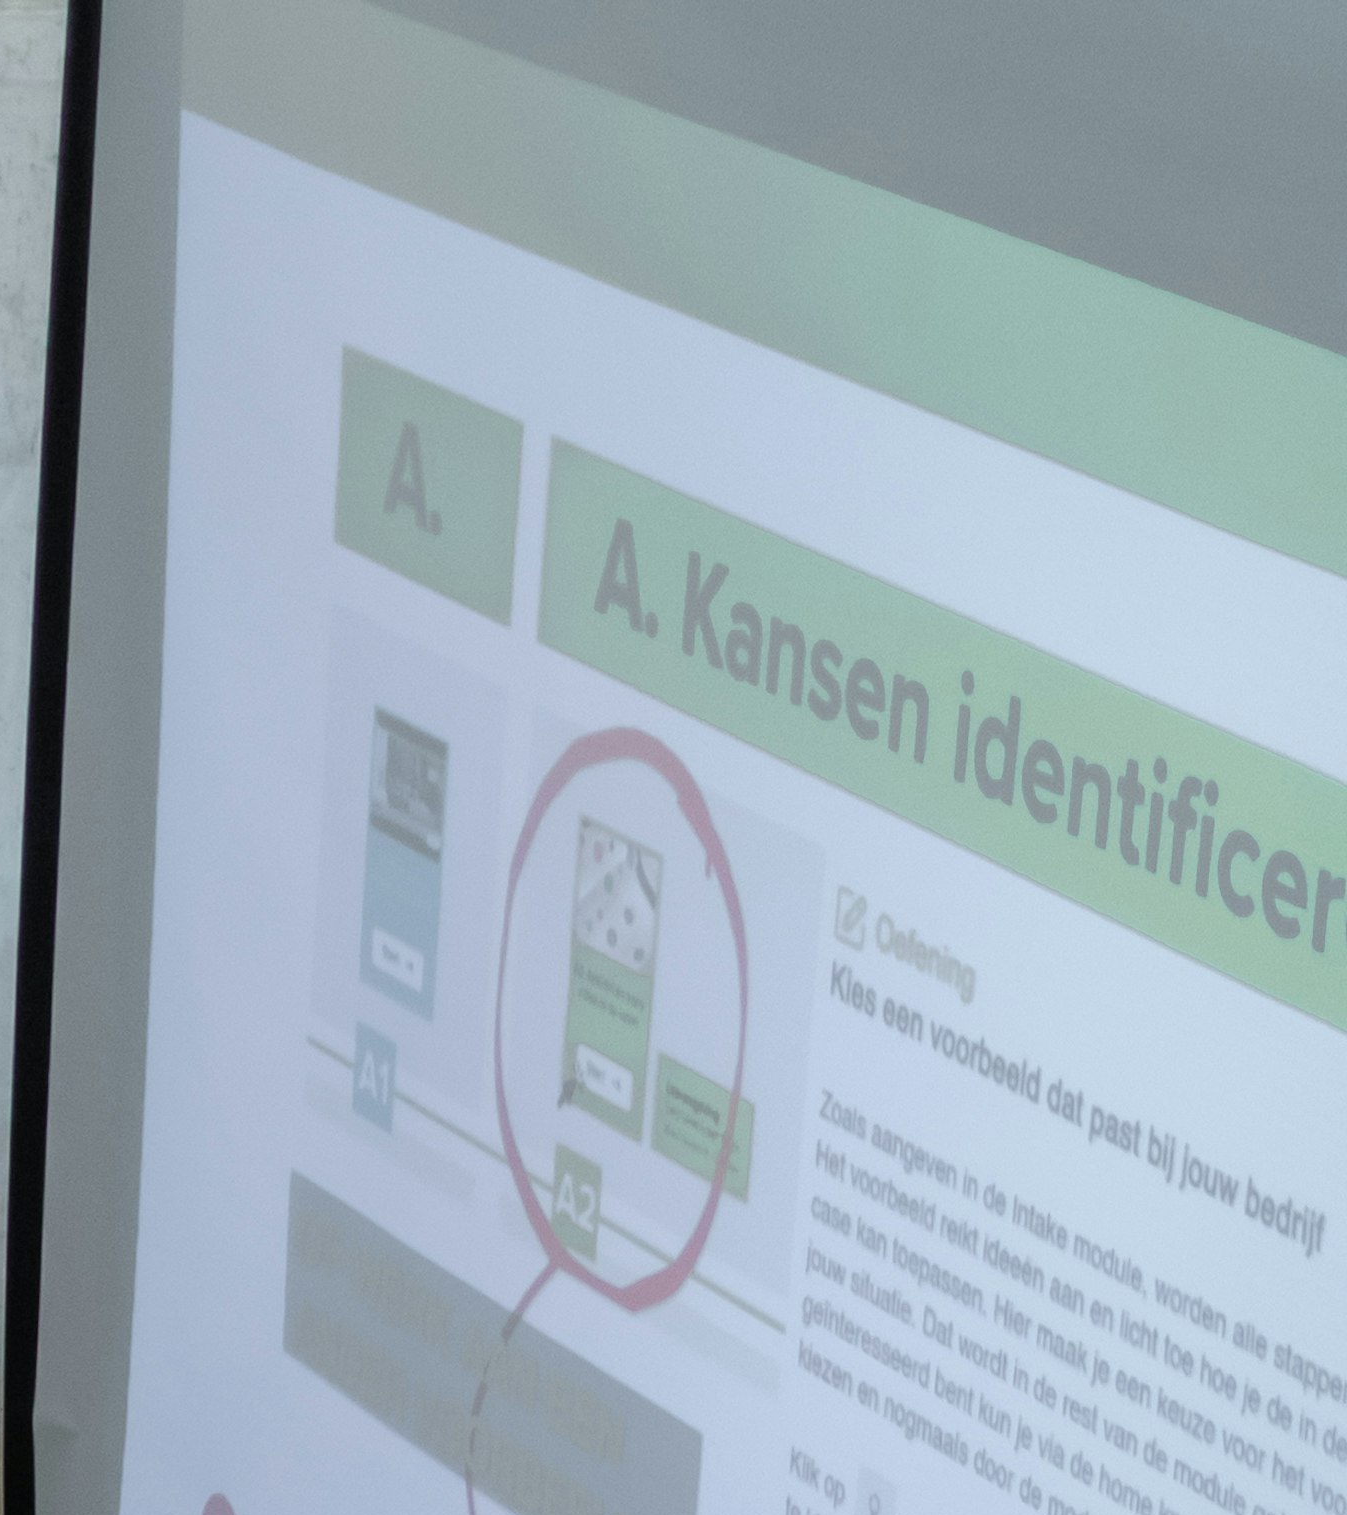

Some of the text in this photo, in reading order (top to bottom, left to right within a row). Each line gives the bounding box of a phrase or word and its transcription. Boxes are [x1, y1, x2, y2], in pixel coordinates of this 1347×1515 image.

[385, 419, 444, 536] A.
[593, 518, 1347, 955] A. Kansen identificer
[875, 914, 975, 1003] Oefening
[358, 1050, 388, 1106] A1
[830, 960, 1326, 1258] Kies een voorbeeld dat past bij jouw bedrijf
[558, 1172, 597, 1234] A2
[818, 1089, 866, 1140] Zoals
[870, 1123, 957, 1189] aangeven
[961, 1169, 978, 1200] in
[982, 1183, 1007, 1217] de
[1011, 1195, 1068, 1251] Intake
[1154, 1278, 1227, 1339] worden
[1231, 1321, 1268, 1361] alle
[805, 1241, 846, 1285] jouw
[849, 1270, 914, 1327] situatie.
[921, 1304, 954, 1349] Dat
[958, 1334, 1008, 1381] wordt
[1012, 1358, 1029, 1394] in
[1032, 1374, 1057, 1410] de
[1061, 1394, 1098, 1434] rest
[1102, 1418, 1138, 1457] van
[1142, 1437, 1168, 1474] de
[810, 1195, 852, 1237] case
[855, 1216, 888, 1259] kan
[892, 1237, 986, 1316] toepassen.
[993, 1293, 1032, 1339] Hier
[1035, 1323, 1088, 1374] maak
[1089, 1350, 1111, 1387] je
[1114, 1368, 1152, 1408] een
[1156, 1386, 1216, 1445] keuze
[1221, 1428, 1266, 1473] voor
[1271, 1450, 1305, 1497] het
[815, 1139, 846, 1182] Het
[849, 1163, 936, 1232] voorbeeld
[939, 1214, 979, 1257] reikt
[1048, 1276, 1085, 1316] aan
[1088, 1299, 1114, 1333] en
[1119, 1309, 1159, 1358] licht
[1163, 1334, 1195, 1377] toe
[1199, 1354, 1238, 1401] hoe
[1240, 1382, 1262, 1416] je
[1265, 1395, 1293, 1432] de
[1298, 1412, 1317, 1446] in
[789, 1446, 820, 1490] Klik
[823, 1474, 845, 1509] op
[797, 1338, 853, 1396] kiezen
[856, 1380, 879, 1412] en
[883, 1396, 969, 1466] nogmaals
[972, 1448, 1014, 1492] door
[1018, 1475, 1042, 1511] de
[933, 1366, 974, 1416] bent
[977, 1393, 1011, 1437] kun
[1013, 1416, 1033, 1452] je
[1037, 1434, 1065, 1470] via
[1068, 1450, 1094, 1486] de
